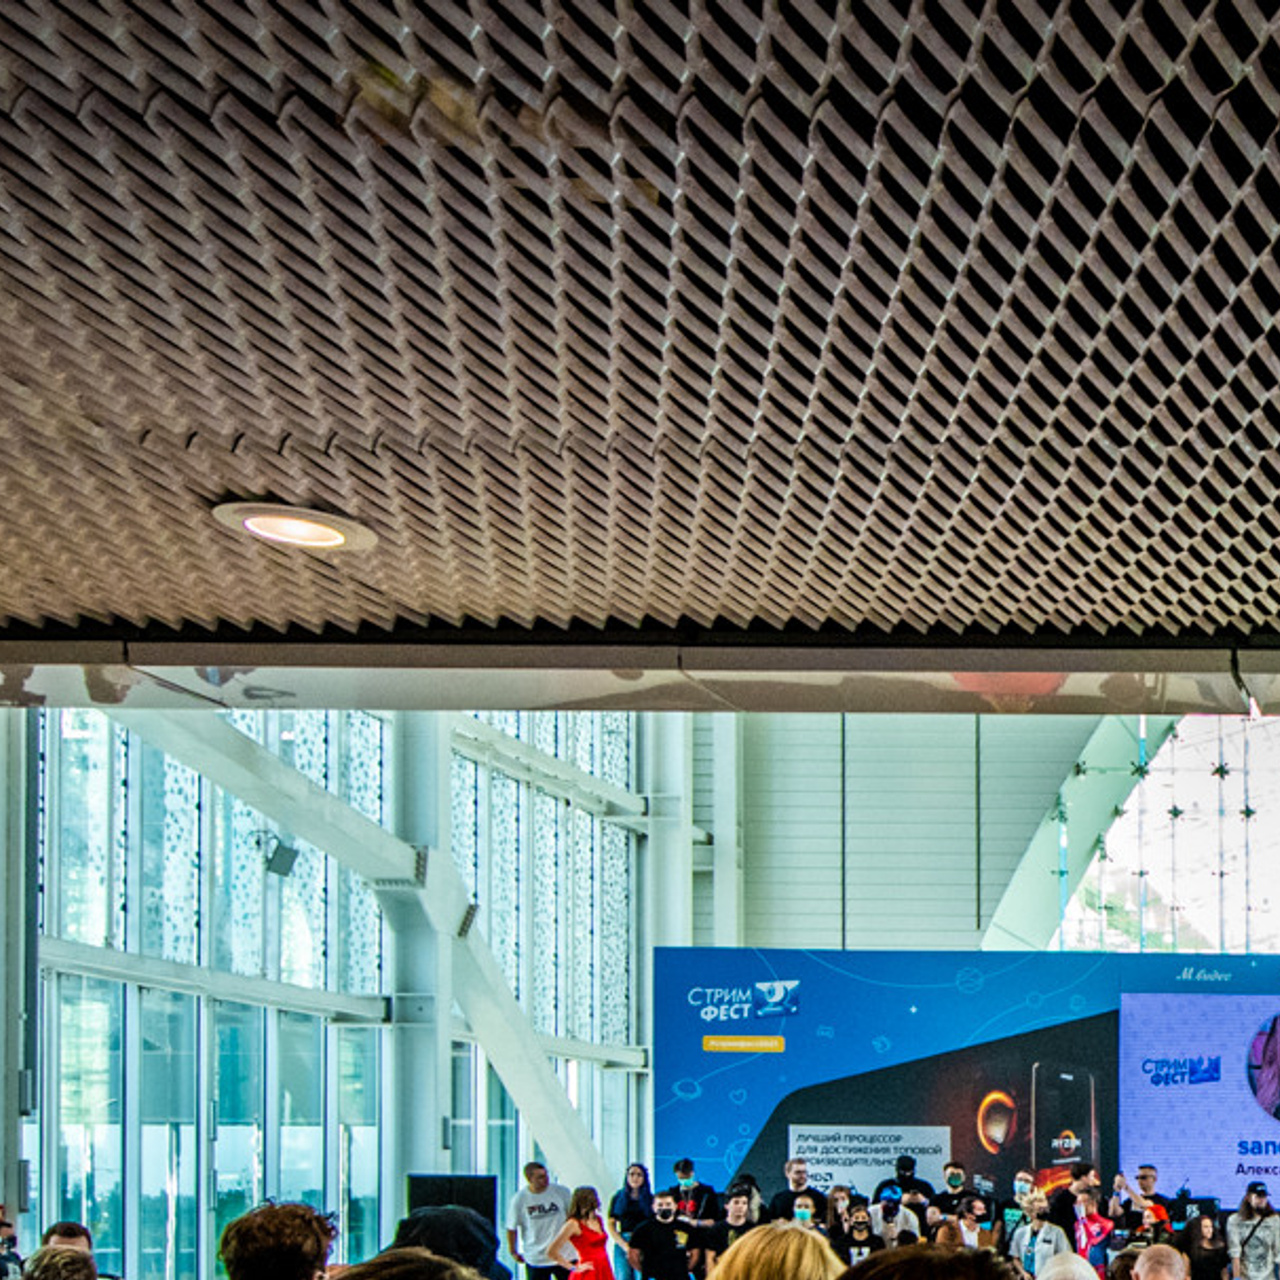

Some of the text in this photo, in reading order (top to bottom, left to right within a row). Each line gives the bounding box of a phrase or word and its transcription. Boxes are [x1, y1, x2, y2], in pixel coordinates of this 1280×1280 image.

[687, 986, 753, 1006] СТРИМ
[700, 1003, 753, 1022] ФЕСТ
[1142, 1057, 1189, 1075] СТРИМ
[1150, 1070, 1189, 1087] ФЕСТ
[527, 1202, 559, 1216] FILA
